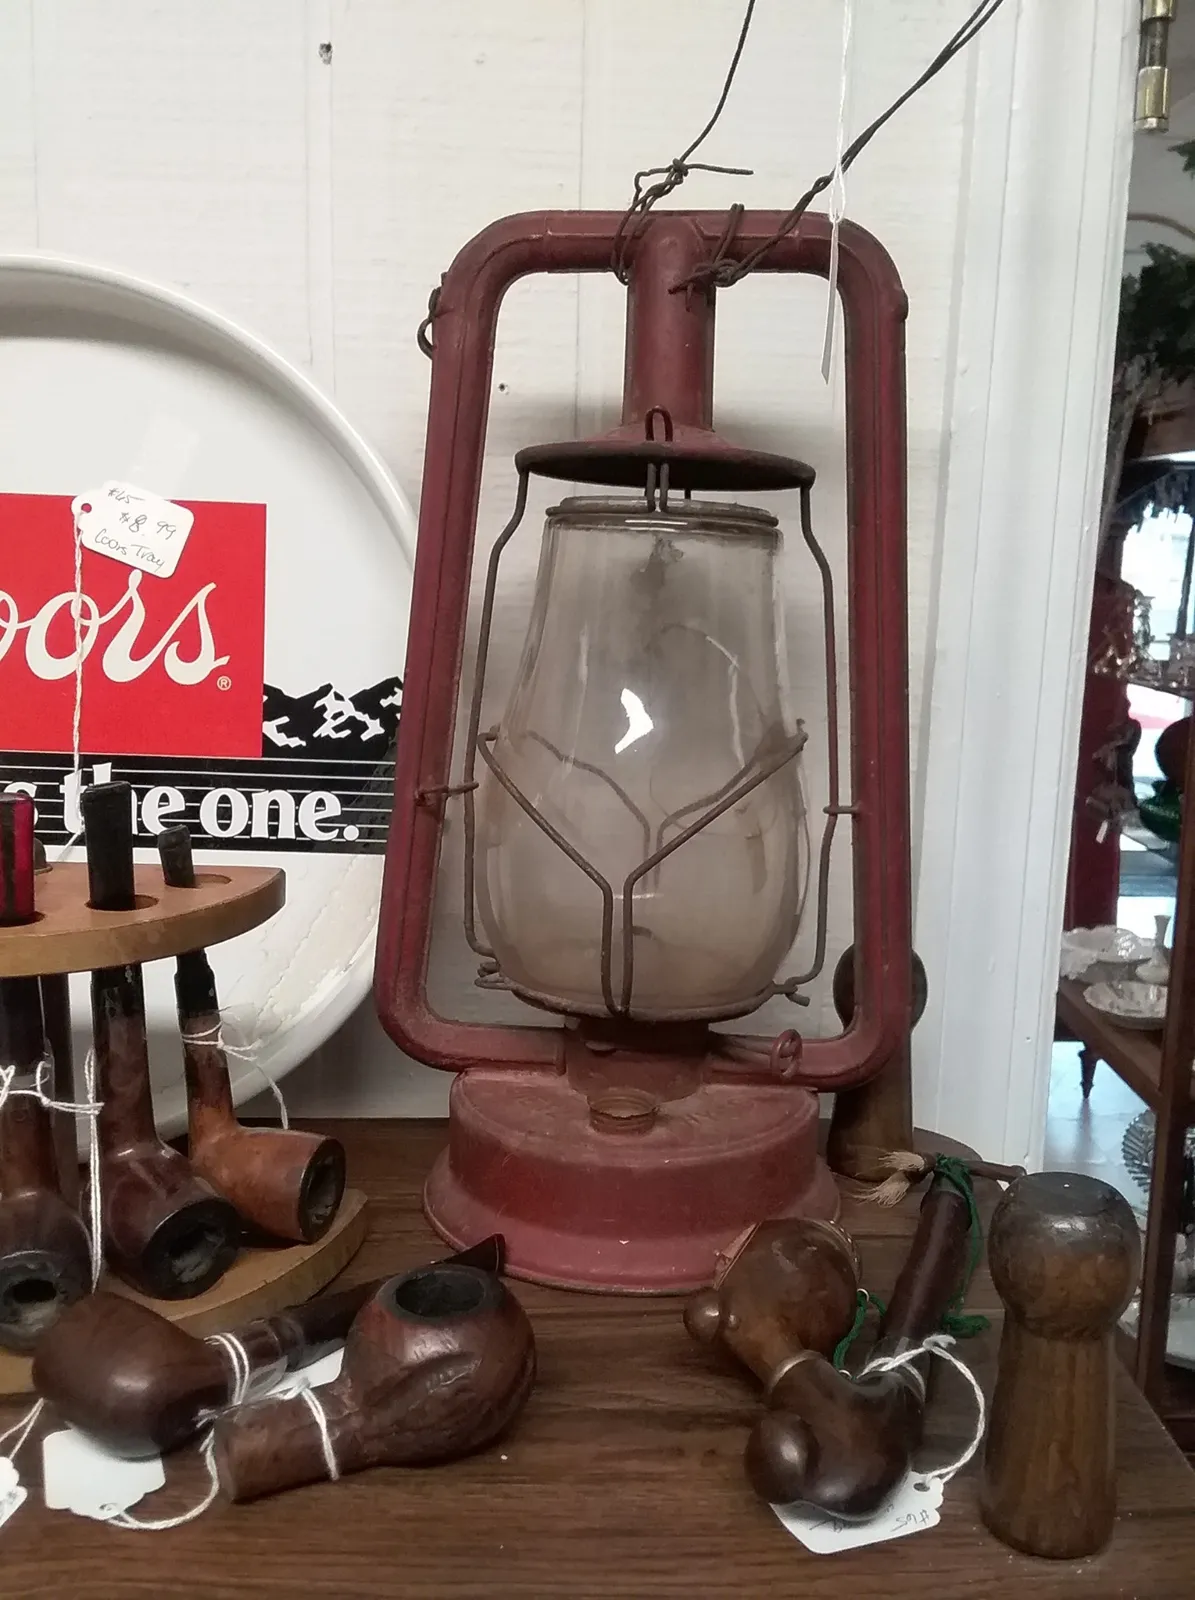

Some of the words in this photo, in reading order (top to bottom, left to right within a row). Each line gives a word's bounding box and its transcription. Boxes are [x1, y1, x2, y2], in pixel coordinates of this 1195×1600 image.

[94, 528, 127, 556] Coors
[130, 544, 166, 573] Tray
[0, 569, 230, 686] ors
[60, 762, 186, 836] te
[199, 786, 360, 842] one.
